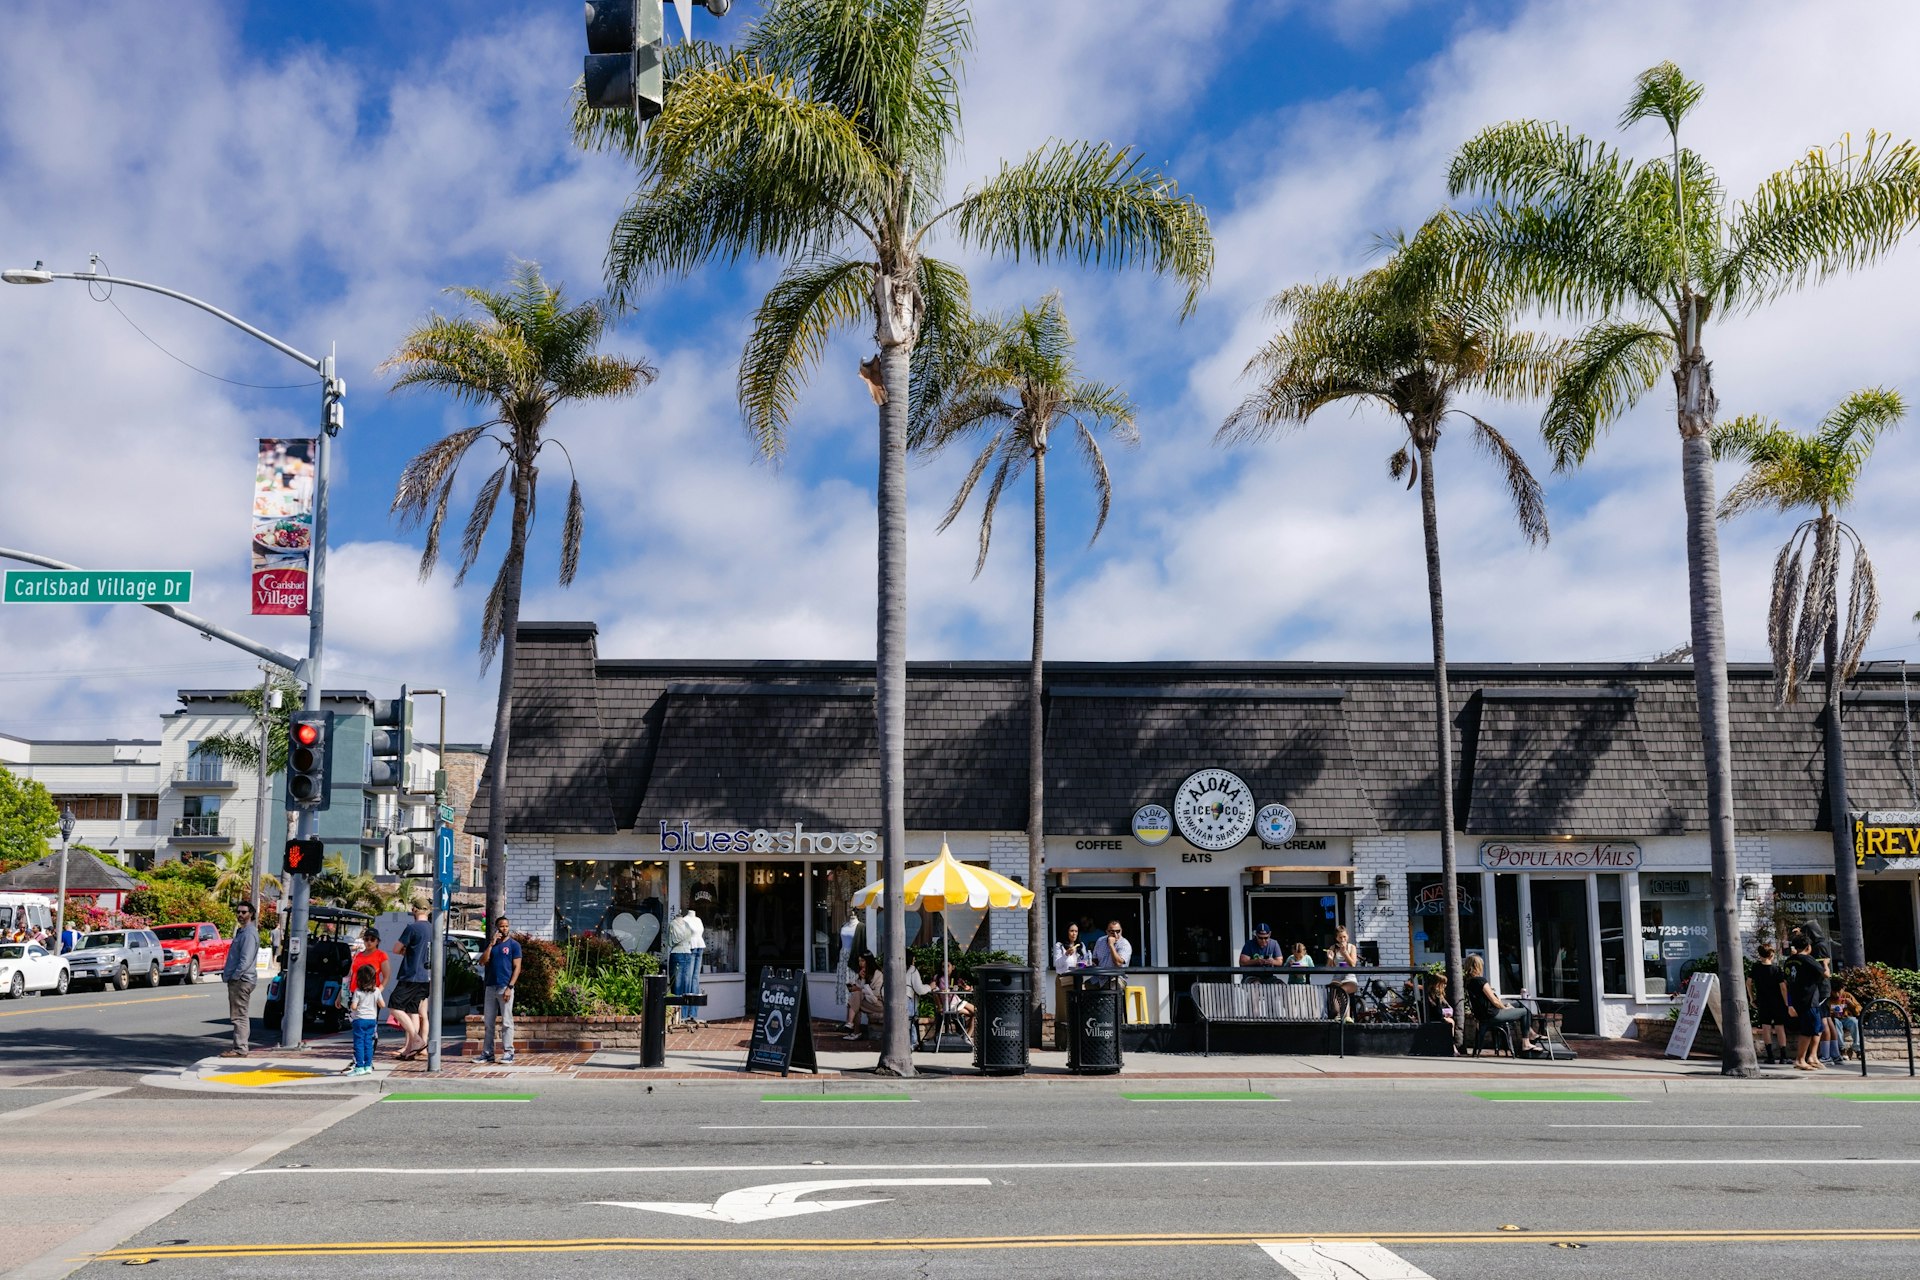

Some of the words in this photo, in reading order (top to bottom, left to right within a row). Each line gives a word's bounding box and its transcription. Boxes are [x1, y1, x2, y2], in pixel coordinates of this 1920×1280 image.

[14, 578, 89, 597] Carlsbad
[97, 578, 157, 600] Village
[164, 579, 183, 596] Dr
[271, 581, 305, 590] Carlsbad
[257, 591, 304, 608] Village
[1188, 777, 1241, 803] ALOHA
[1138, 808, 1167, 822] ALOHA
[1193, 806, 1211, 815] ICE
[1225, 806, 1239, 816] CO
[1261, 808, 1289, 822] ALOHA
[1183, 809, 1213, 841] HAWAIIAN
[1216, 824, 1239, 841] SHAVE
[1237, 810, 1246, 824] ICE
[659, 819, 878, 854] blues&shoes
[1856, 821, 1865, 865] RAGZ
[1075, 841, 1123, 850] COFFEE
[1261, 840, 1282, 850] ICE
[1284, 841, 1327, 850] CREAM
[442, 836, 451, 874] P
[1182, 853, 1213, 863] EATS
[1487, 845, 1573, 866] POPULAR
[1574, 844, 1635, 866] NAILS
[1424, 886, 1463, 900] NAS
[1655, 881, 1688, 892] OPEN
[1798, 891, 1829, 901] Carrying
[1371, 906, 1394, 917] 445
[1776, 902, 1835, 912] BRKENSTOCK
[1525, 913, 1533, 937] 435
[1641, 926, 1657, 934] (760)
[761, 990, 795, 1006] Coffee
[991, 1027, 1020, 1039] Village
[1085, 1027, 1114, 1039] Village
